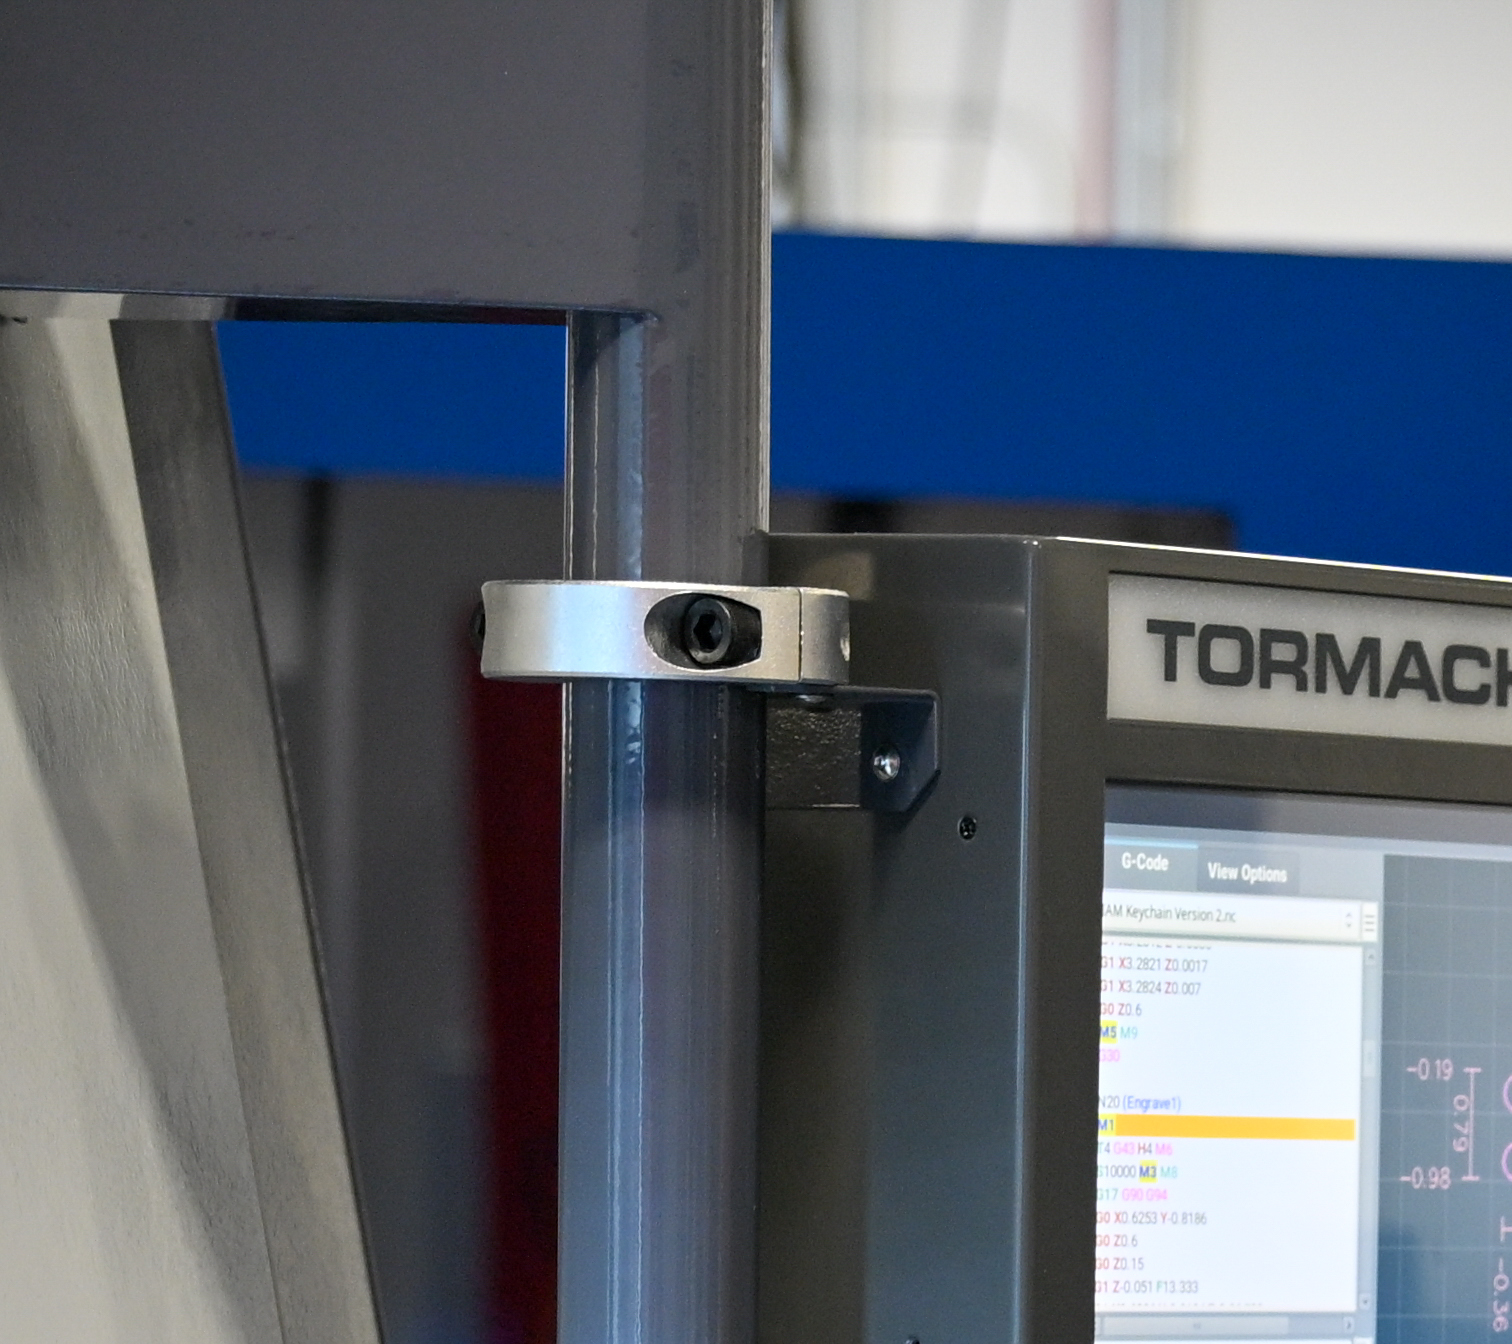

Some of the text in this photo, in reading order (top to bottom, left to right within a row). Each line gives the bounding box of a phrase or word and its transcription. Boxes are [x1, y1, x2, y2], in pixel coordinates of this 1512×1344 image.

[1122, 852, 1170, 871] G-Code
[1208, 861, 1288, 885] View Options
[1126, 904, 1172, 923] Keychain
[1175, 907, 1214, 922] Version
